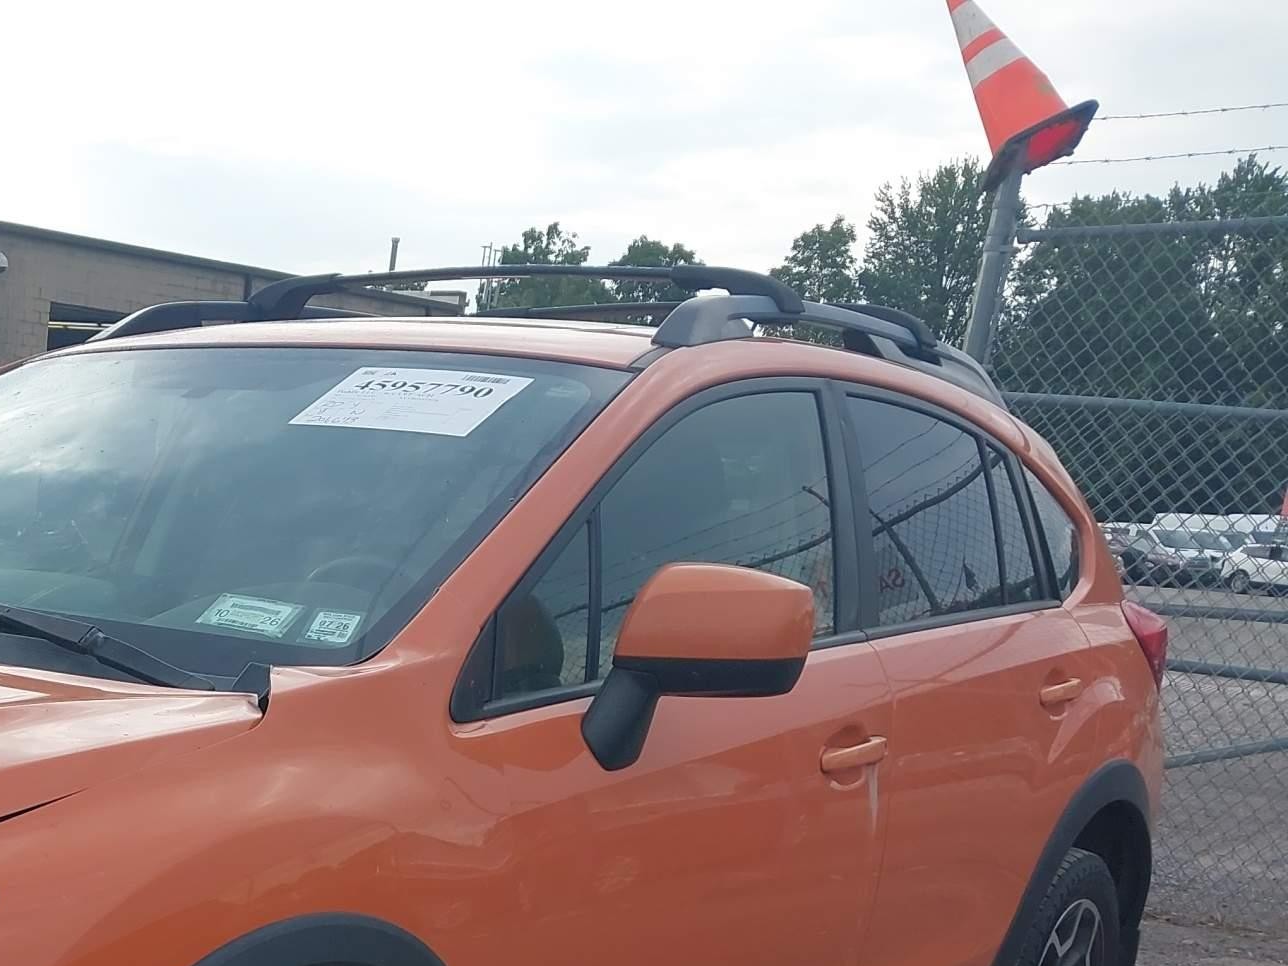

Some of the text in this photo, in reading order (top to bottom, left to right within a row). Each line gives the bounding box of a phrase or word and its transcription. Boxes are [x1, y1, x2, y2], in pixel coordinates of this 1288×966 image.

[352, 379, 494, 398] 45957790
[214, 608, 230, 618] 10
[260, 616, 280, 626] 26
